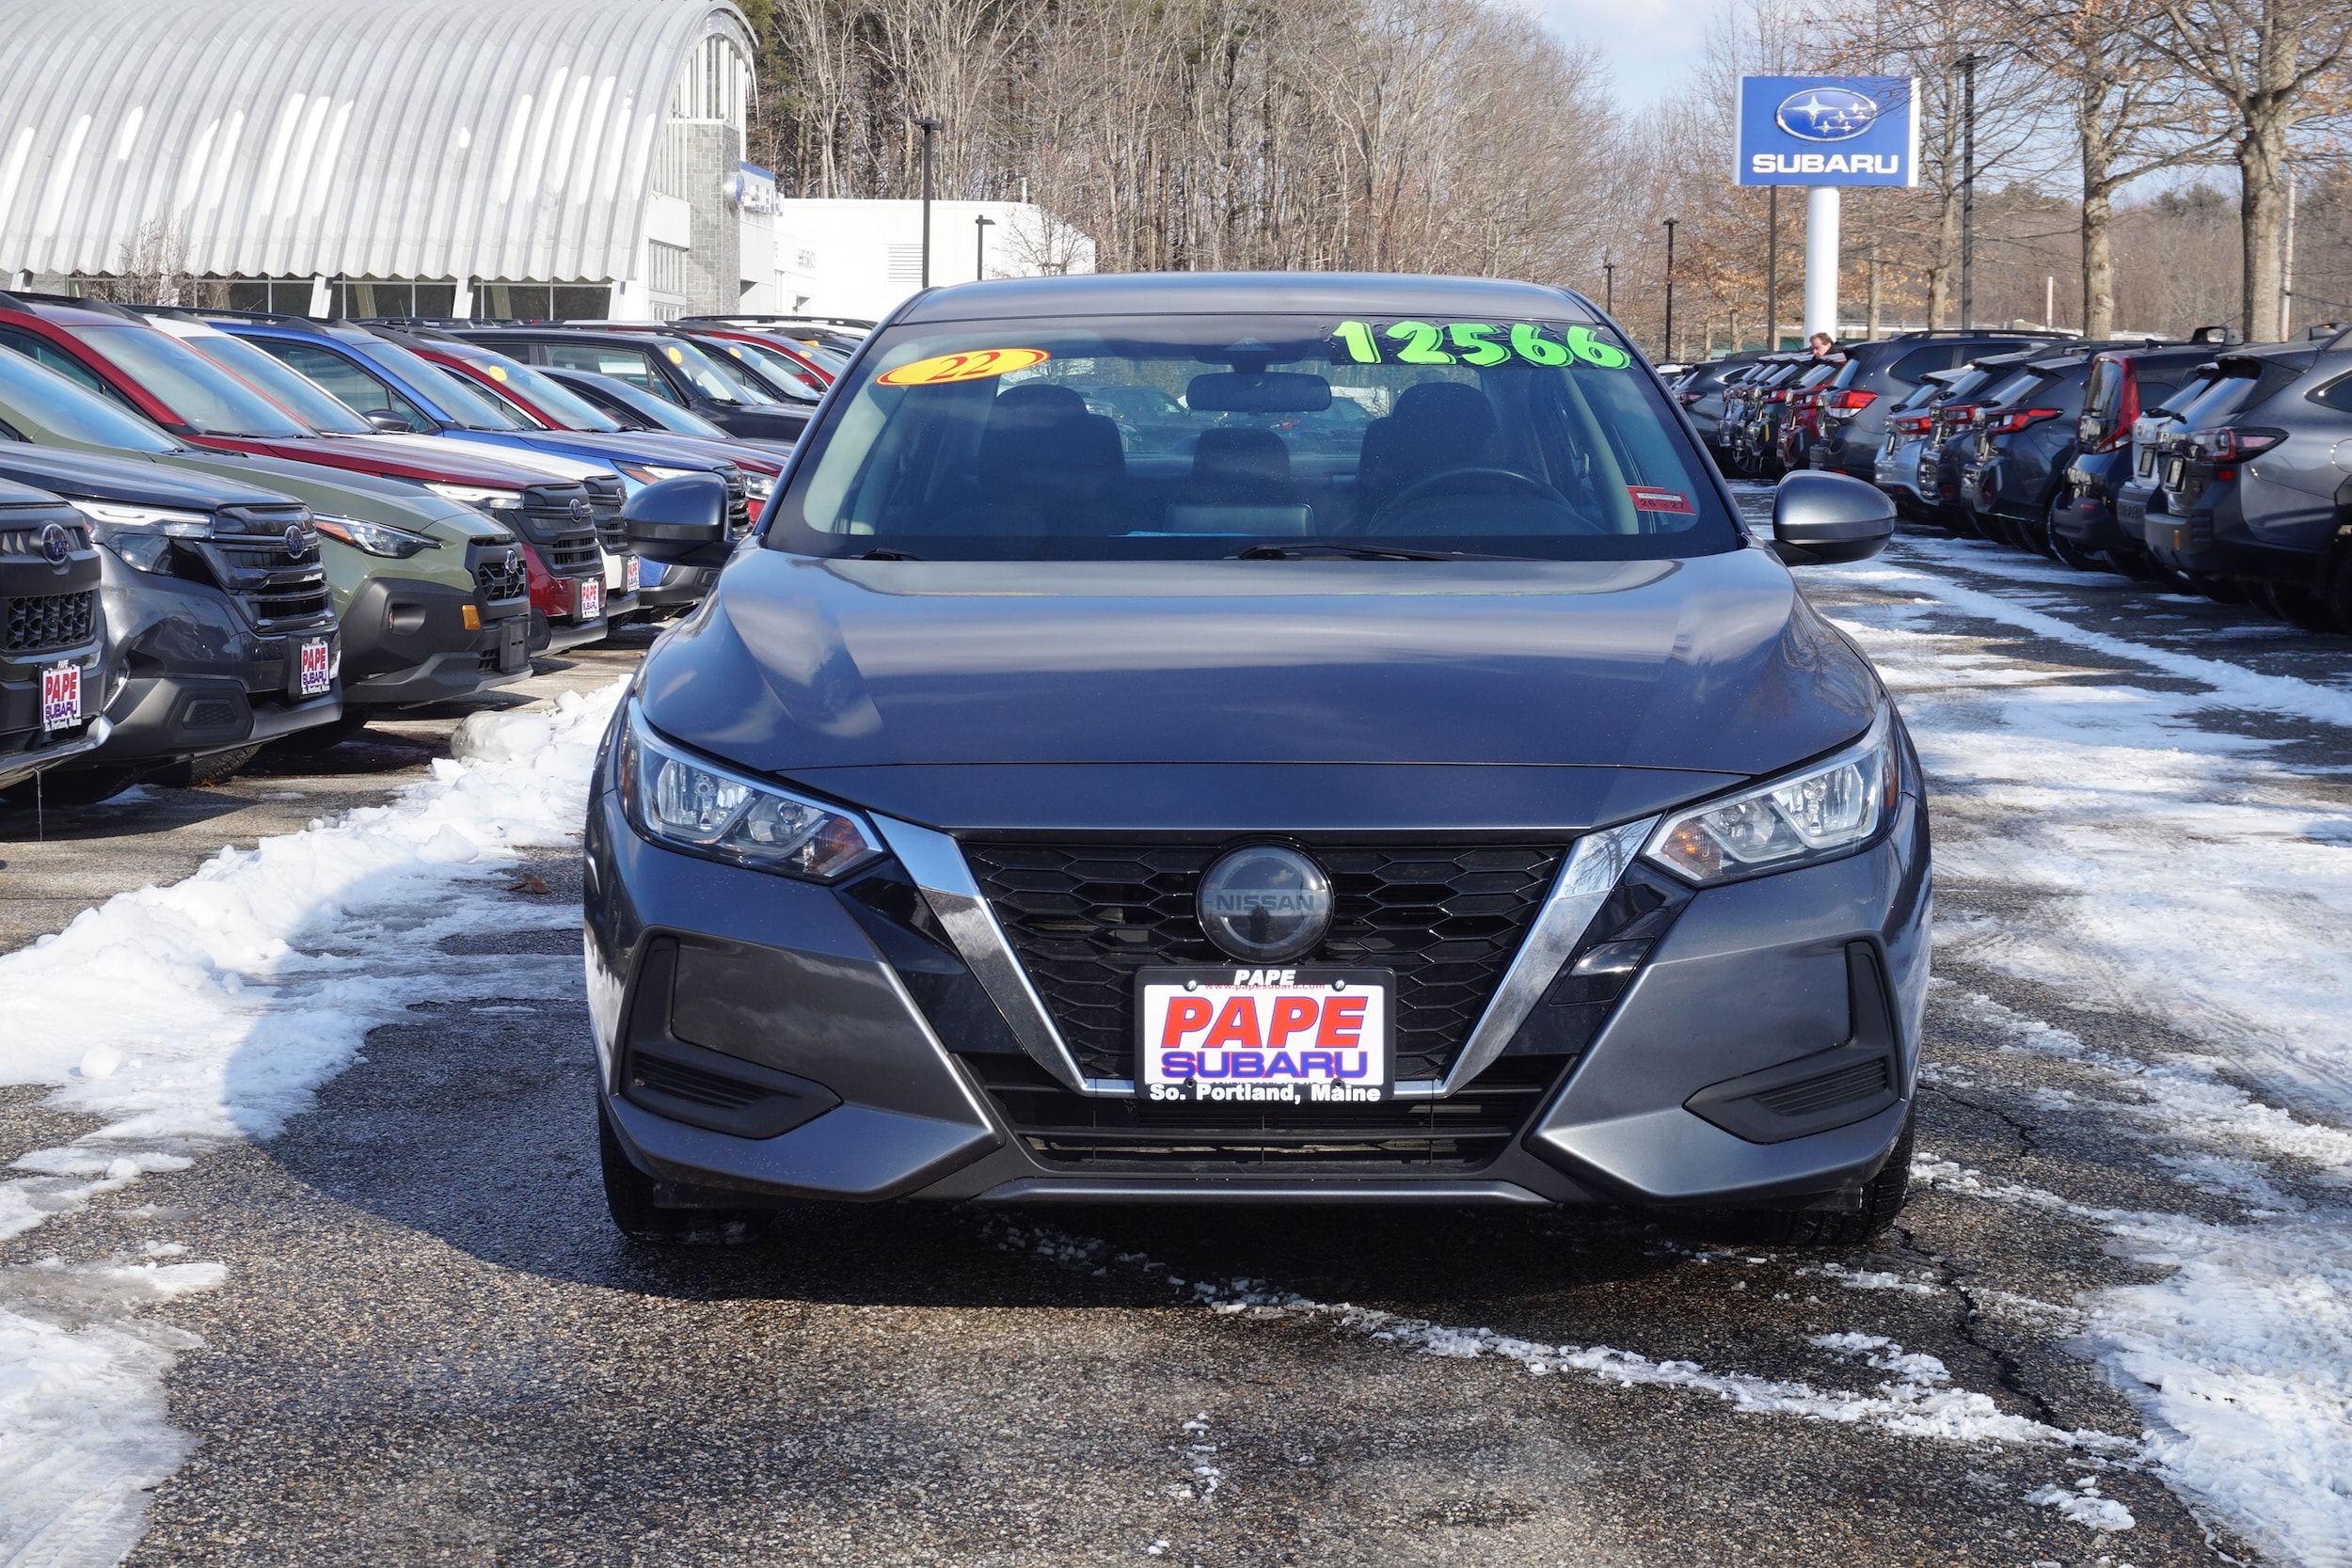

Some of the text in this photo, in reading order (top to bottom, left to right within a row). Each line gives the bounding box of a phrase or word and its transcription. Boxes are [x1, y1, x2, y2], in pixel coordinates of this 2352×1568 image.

[1753, 153, 1899, 174] SUBARU
[1332, 321, 1632, 370] 12566
[925, 352, 1001, 382] 22
[303, 648, 326, 672] PAPE
[45, 672, 77, 705] PAPE
[45, 700, 77, 720] SUBARU
[1216, 895, 1314, 911] NISSAN
[1233, 970, 1296, 986] PAPE
[1161, 996, 1369, 1048] PAPE
[1161, 1052, 1368, 1078] SUBARU
[1150, 1084, 1381, 1104] So. Portland, Maine
